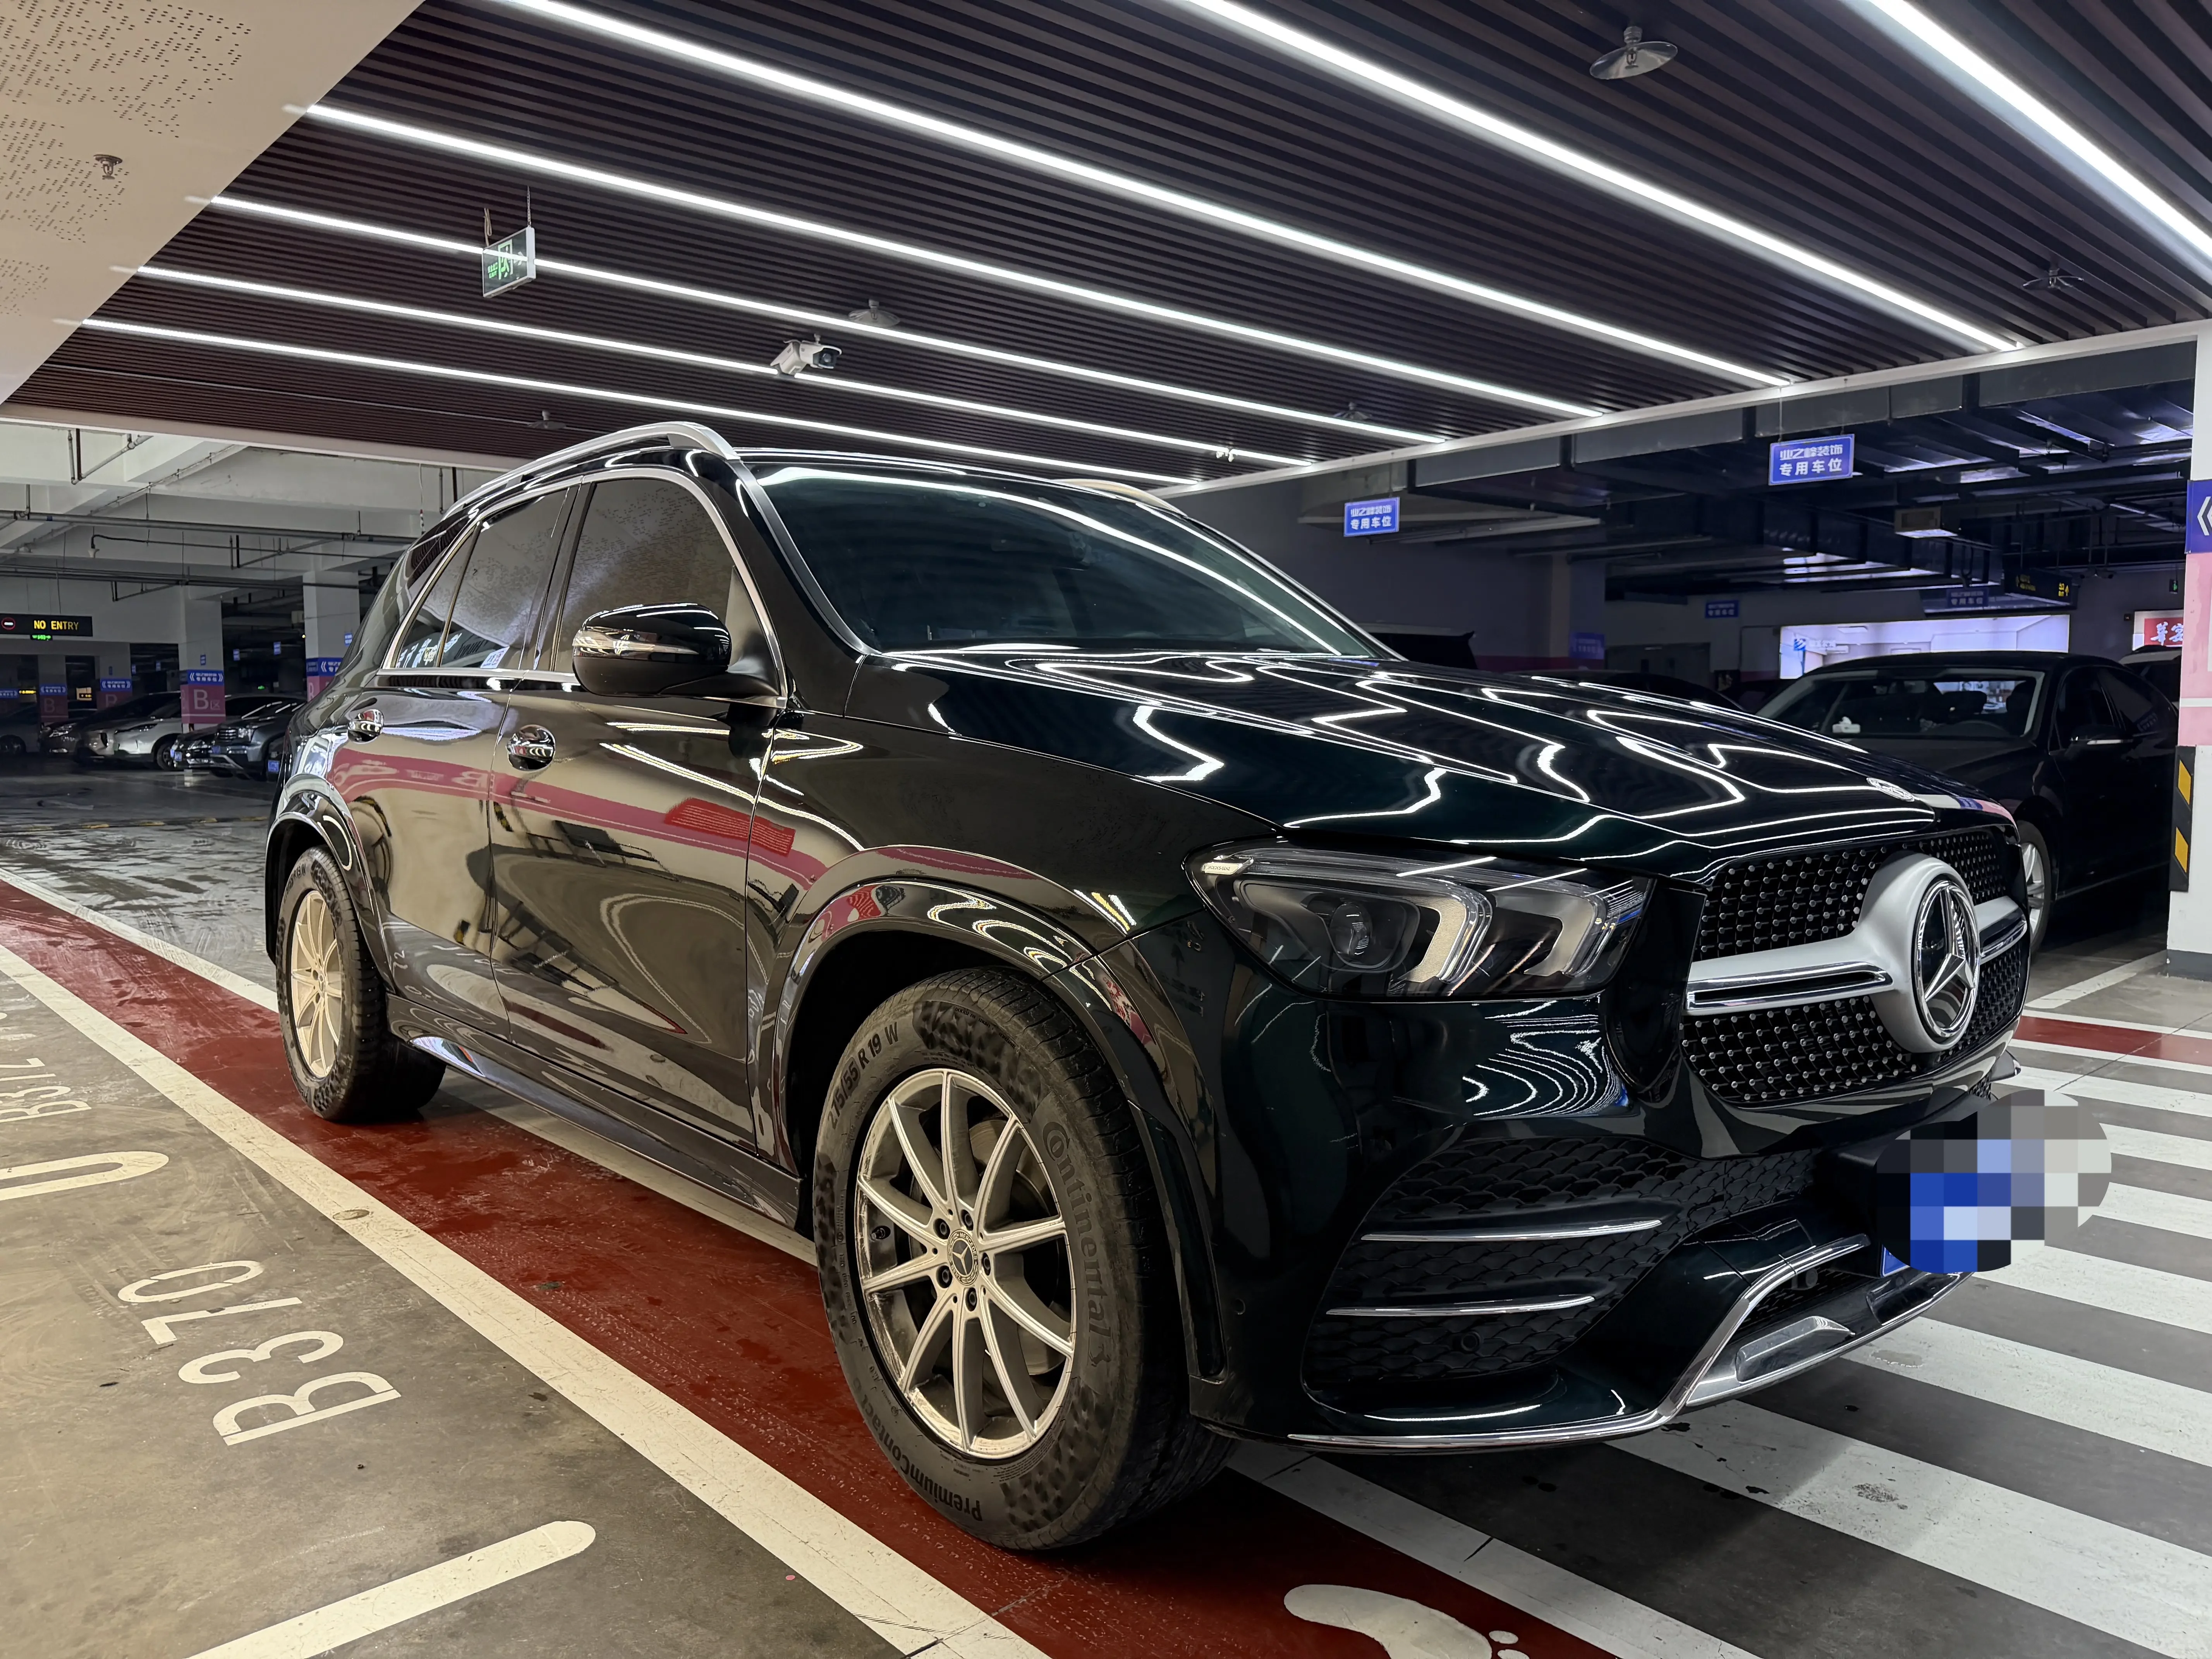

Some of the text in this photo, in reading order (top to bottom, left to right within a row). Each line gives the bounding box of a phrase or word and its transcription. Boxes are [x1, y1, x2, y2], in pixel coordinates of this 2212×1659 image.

[1779, 458, 1842, 477] 专用车位
[1350, 516, 1392, 530] 专用车位
[34, 620, 79, 630] NO ENTRY
[828, 1021, 898, 1130] 275/55 R 19 W
[1042, 1121, 1111, 1338] Continental
[118, 1260, 401, 1446] B370
[860, 1394, 983, 1522] PremiumContact
